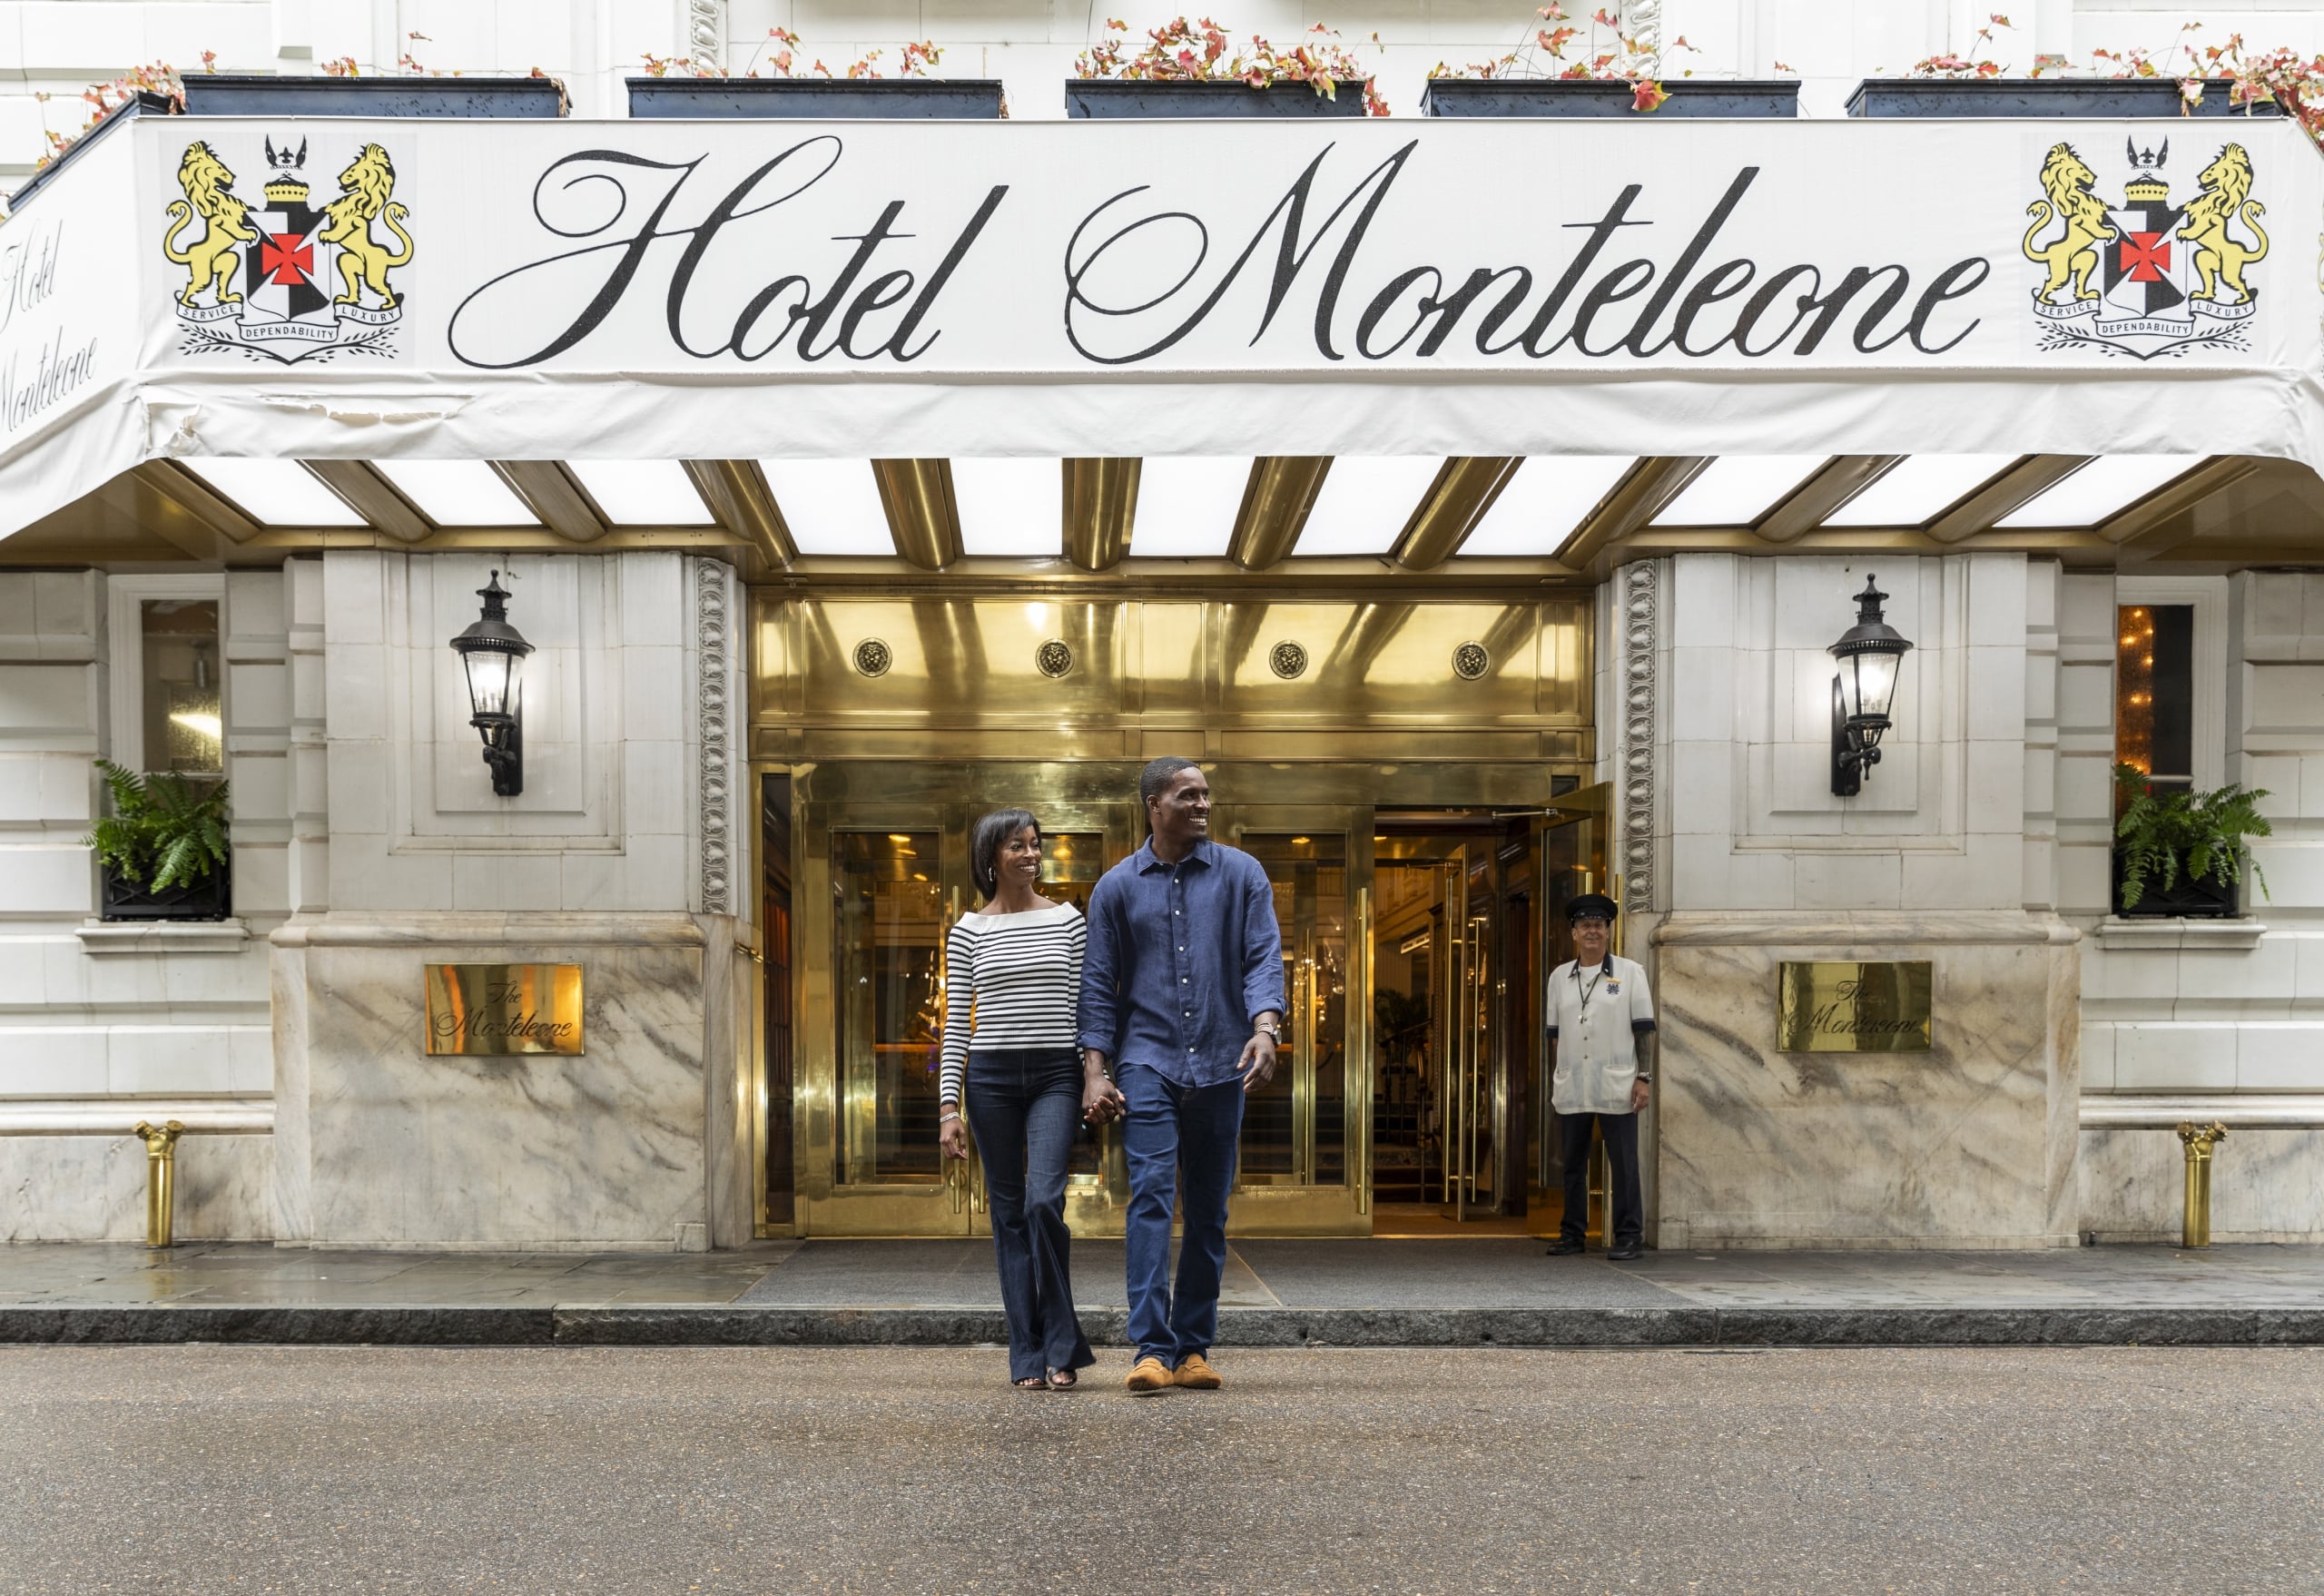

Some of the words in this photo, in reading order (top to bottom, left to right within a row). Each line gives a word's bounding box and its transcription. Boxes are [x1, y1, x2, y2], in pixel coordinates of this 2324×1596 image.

[448, 136, 1009, 369] Hotel
[1065, 140, 1990, 364] Monteleone
[0, 218, 63, 334] Hotel
[183, 305, 235, 320] SERVICE
[342, 305, 396, 322] LUXURY
[2040, 300, 2093, 317] SERVICE
[2197, 301, 2250, 317] LUXURY
[245, 326, 335, 340] DEPENDABILITY
[2102, 322, 2190, 334] DEPENDABILITY
[486, 980, 522, 1004] The
[436, 1005, 573, 1037] Monteleone
